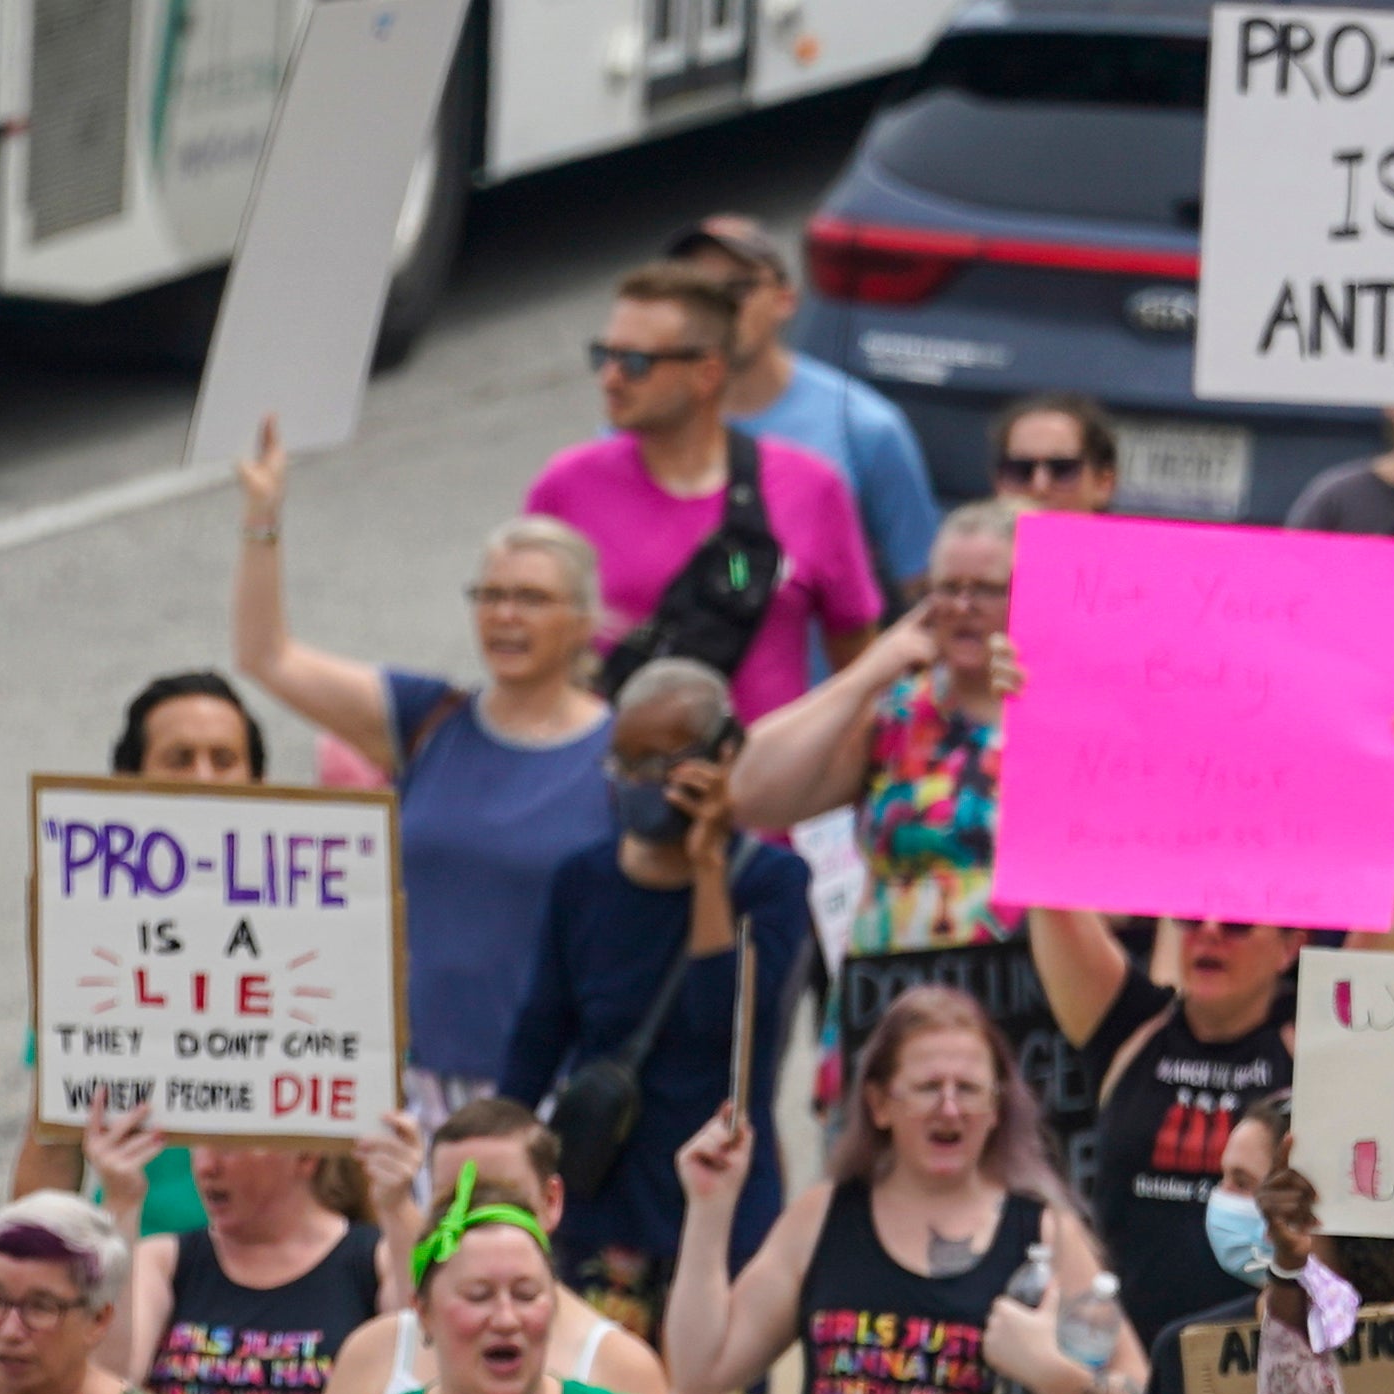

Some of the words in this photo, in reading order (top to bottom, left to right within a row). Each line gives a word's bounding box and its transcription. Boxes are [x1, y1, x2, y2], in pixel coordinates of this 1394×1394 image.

[136, 919, 185, 955] IS
[225, 916, 263, 960] A
[132, 966, 274, 1016] LIE
[54, 1026, 144, 1056] THEY
[281, 1032, 360, 1062] CARE
[63, 1076, 155, 1112] WHEN
[164, 1078, 255, 1113] PEOPLE
[269, 1071, 357, 1121] DIE
